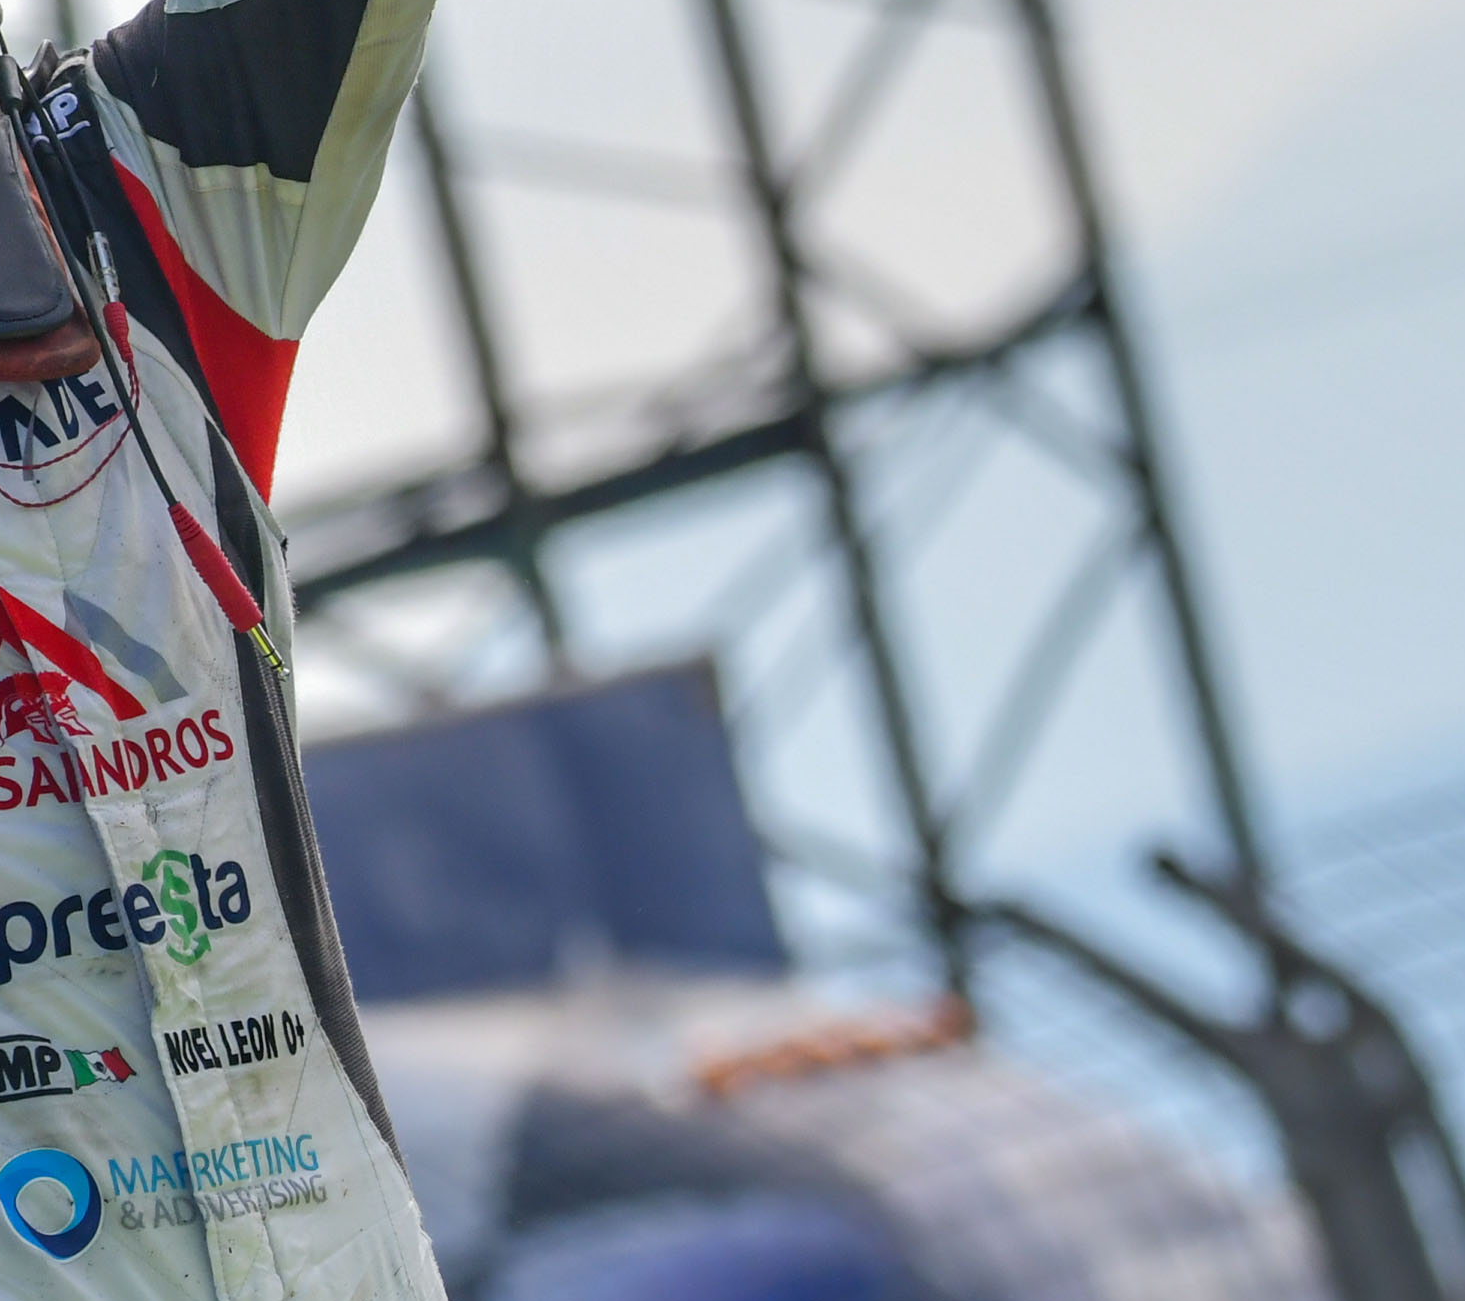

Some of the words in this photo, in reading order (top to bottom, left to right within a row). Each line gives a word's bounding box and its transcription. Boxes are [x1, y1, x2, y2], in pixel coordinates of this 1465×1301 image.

[164, 1026, 222, 1076] NOEL
[219, 1015, 280, 1067] LEON
[121, 1200, 145, 1230] &
